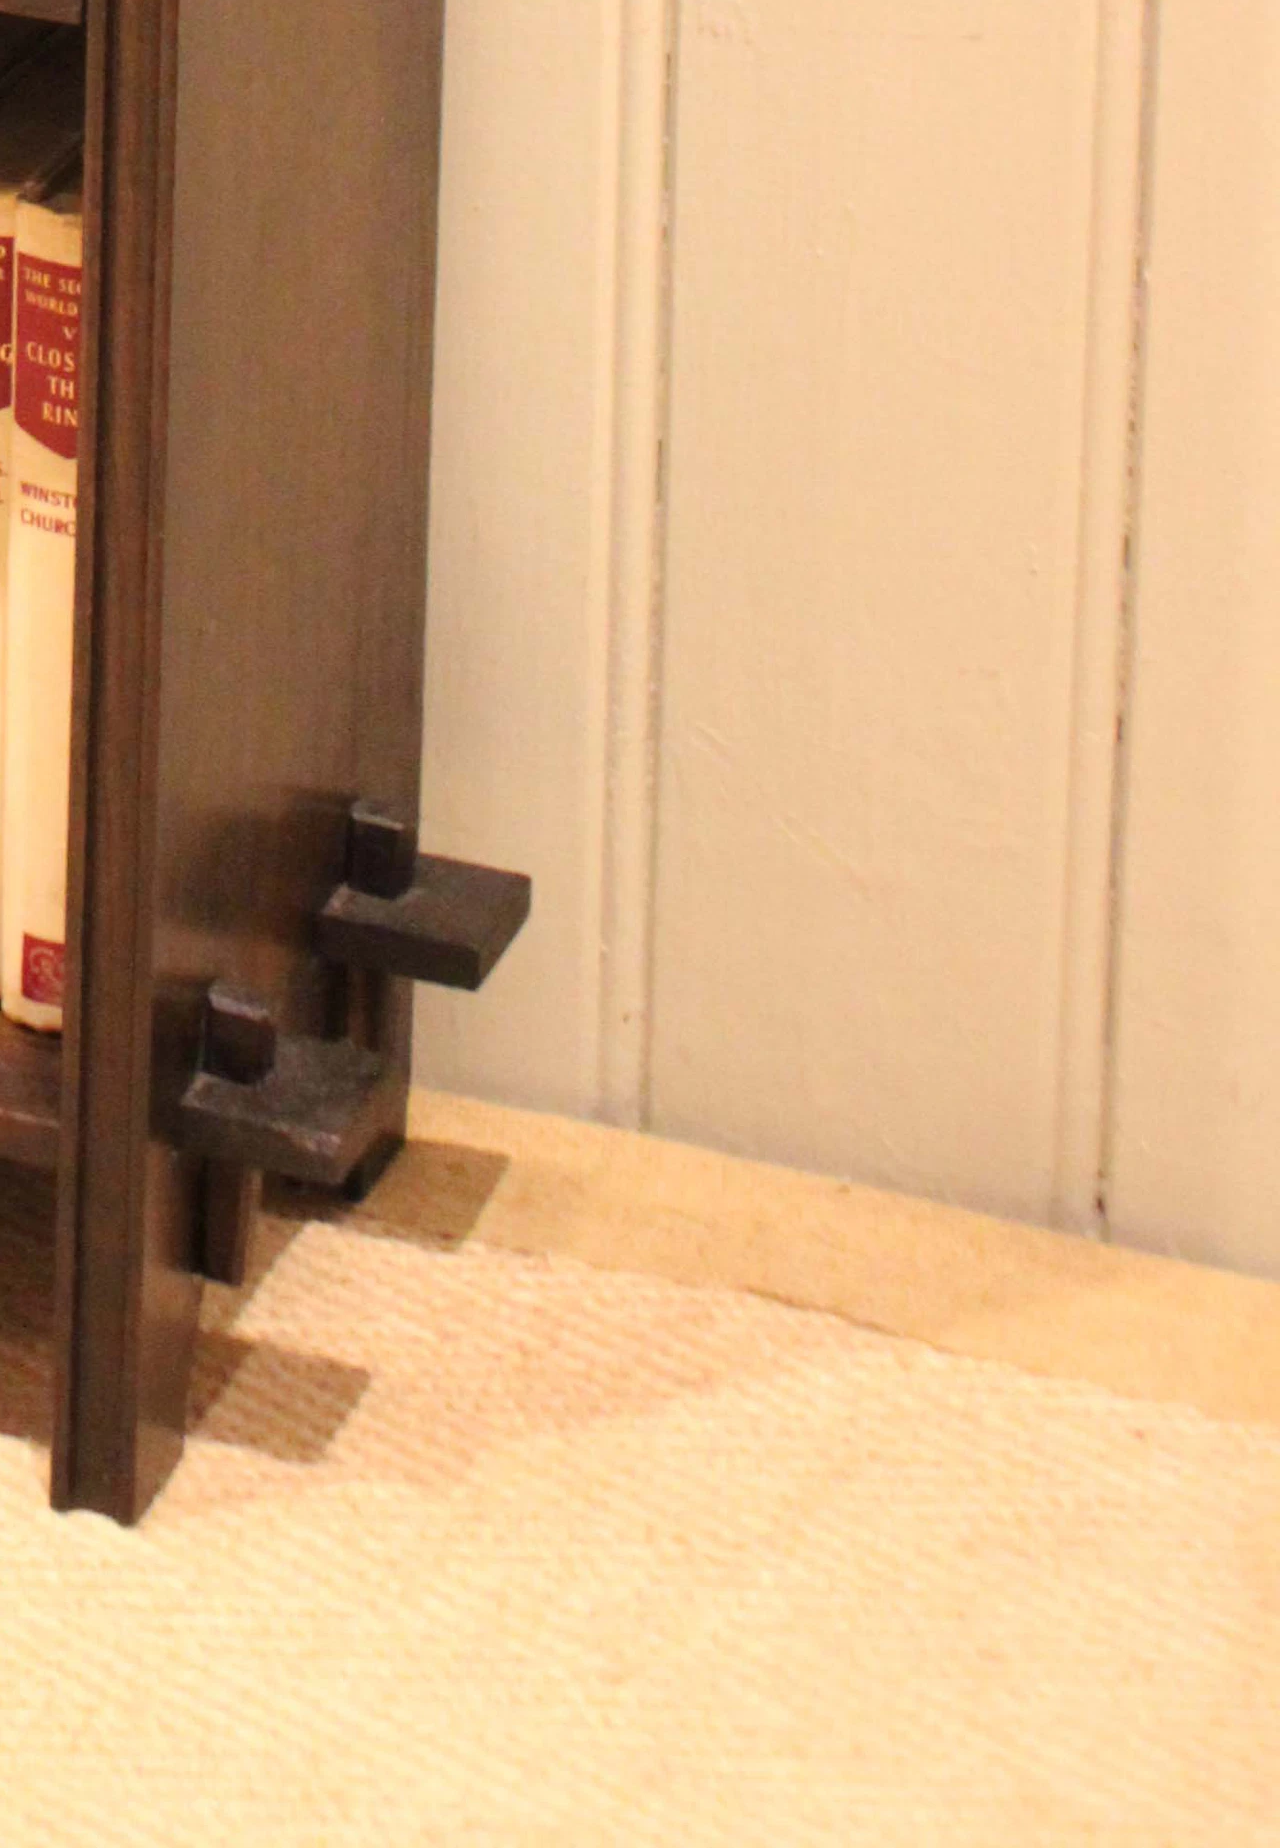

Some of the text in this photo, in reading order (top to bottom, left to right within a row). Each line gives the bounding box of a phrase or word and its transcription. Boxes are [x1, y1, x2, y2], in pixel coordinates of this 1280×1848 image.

[23, 265, 52, 290] THE
[24, 288, 79, 318] WORLD
[44, 375, 76, 401] TH
[41, 402, 79, 429] RIN
